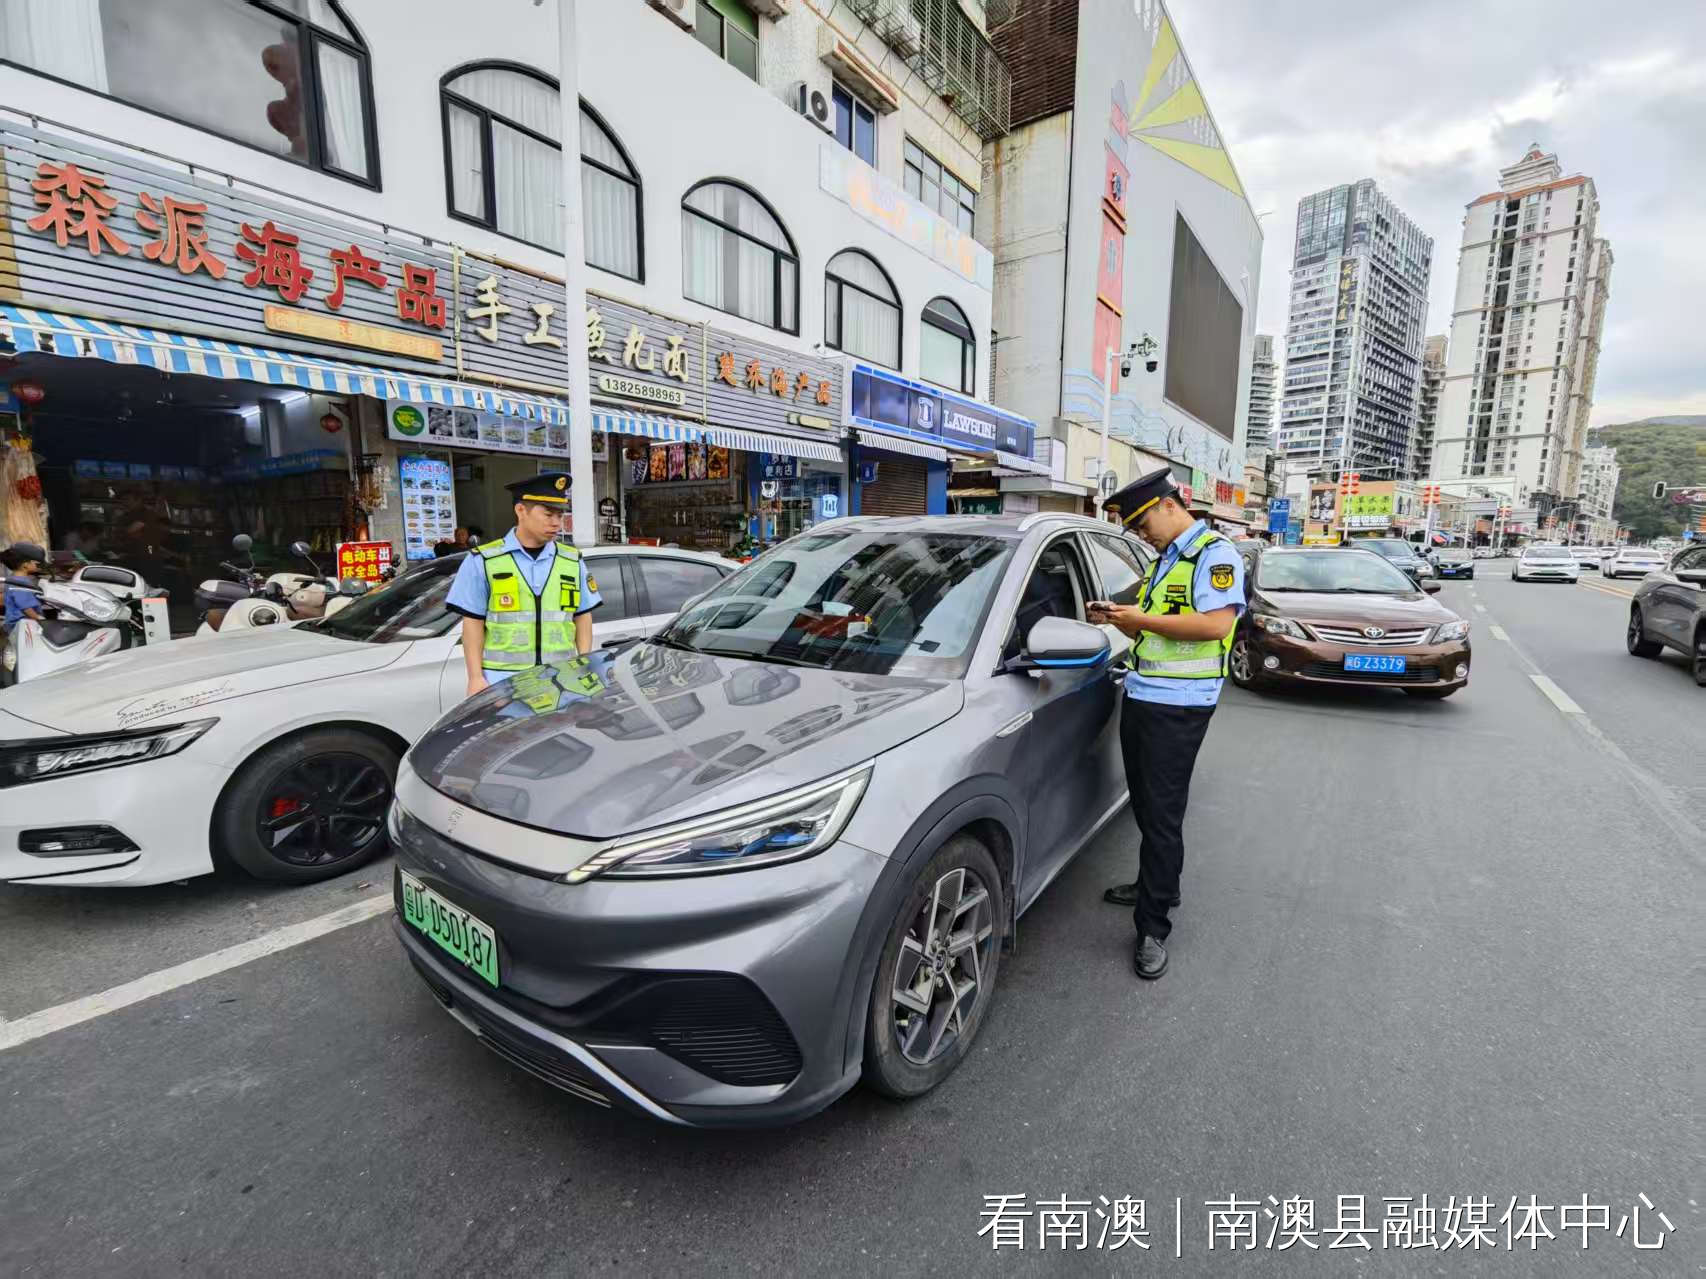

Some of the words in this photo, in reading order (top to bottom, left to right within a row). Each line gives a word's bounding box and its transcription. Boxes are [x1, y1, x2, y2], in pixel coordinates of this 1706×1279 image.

[26, 162, 447, 329] 森派海产品
[605, 377, 682, 403] 13825898963
[342, 549, 378, 564] 电动车
